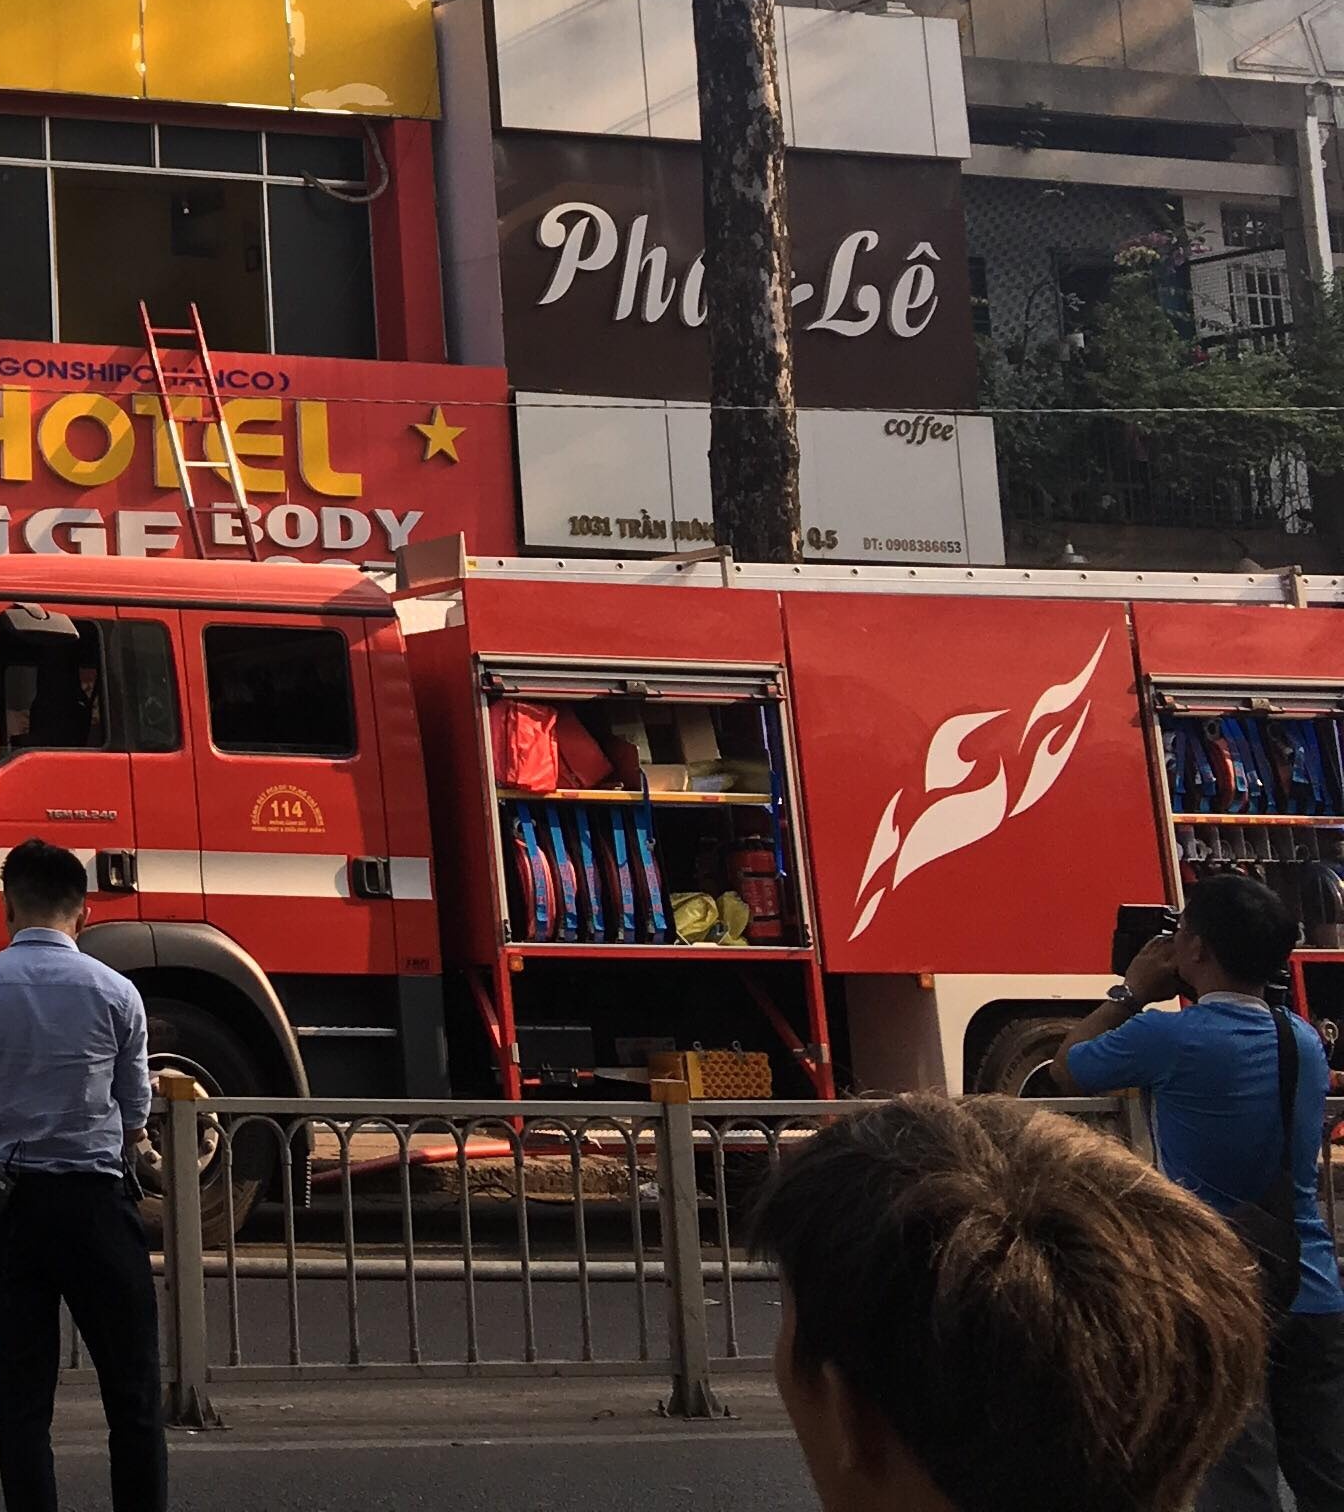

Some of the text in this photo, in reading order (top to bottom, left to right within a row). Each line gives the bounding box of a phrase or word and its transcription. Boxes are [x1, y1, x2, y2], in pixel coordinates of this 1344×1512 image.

[805, 229, 941, 339] Lê
[884, 415, 955, 445] coffee
[211, 501, 424, 552] BODY
[271, 799, 304, 819] 114
